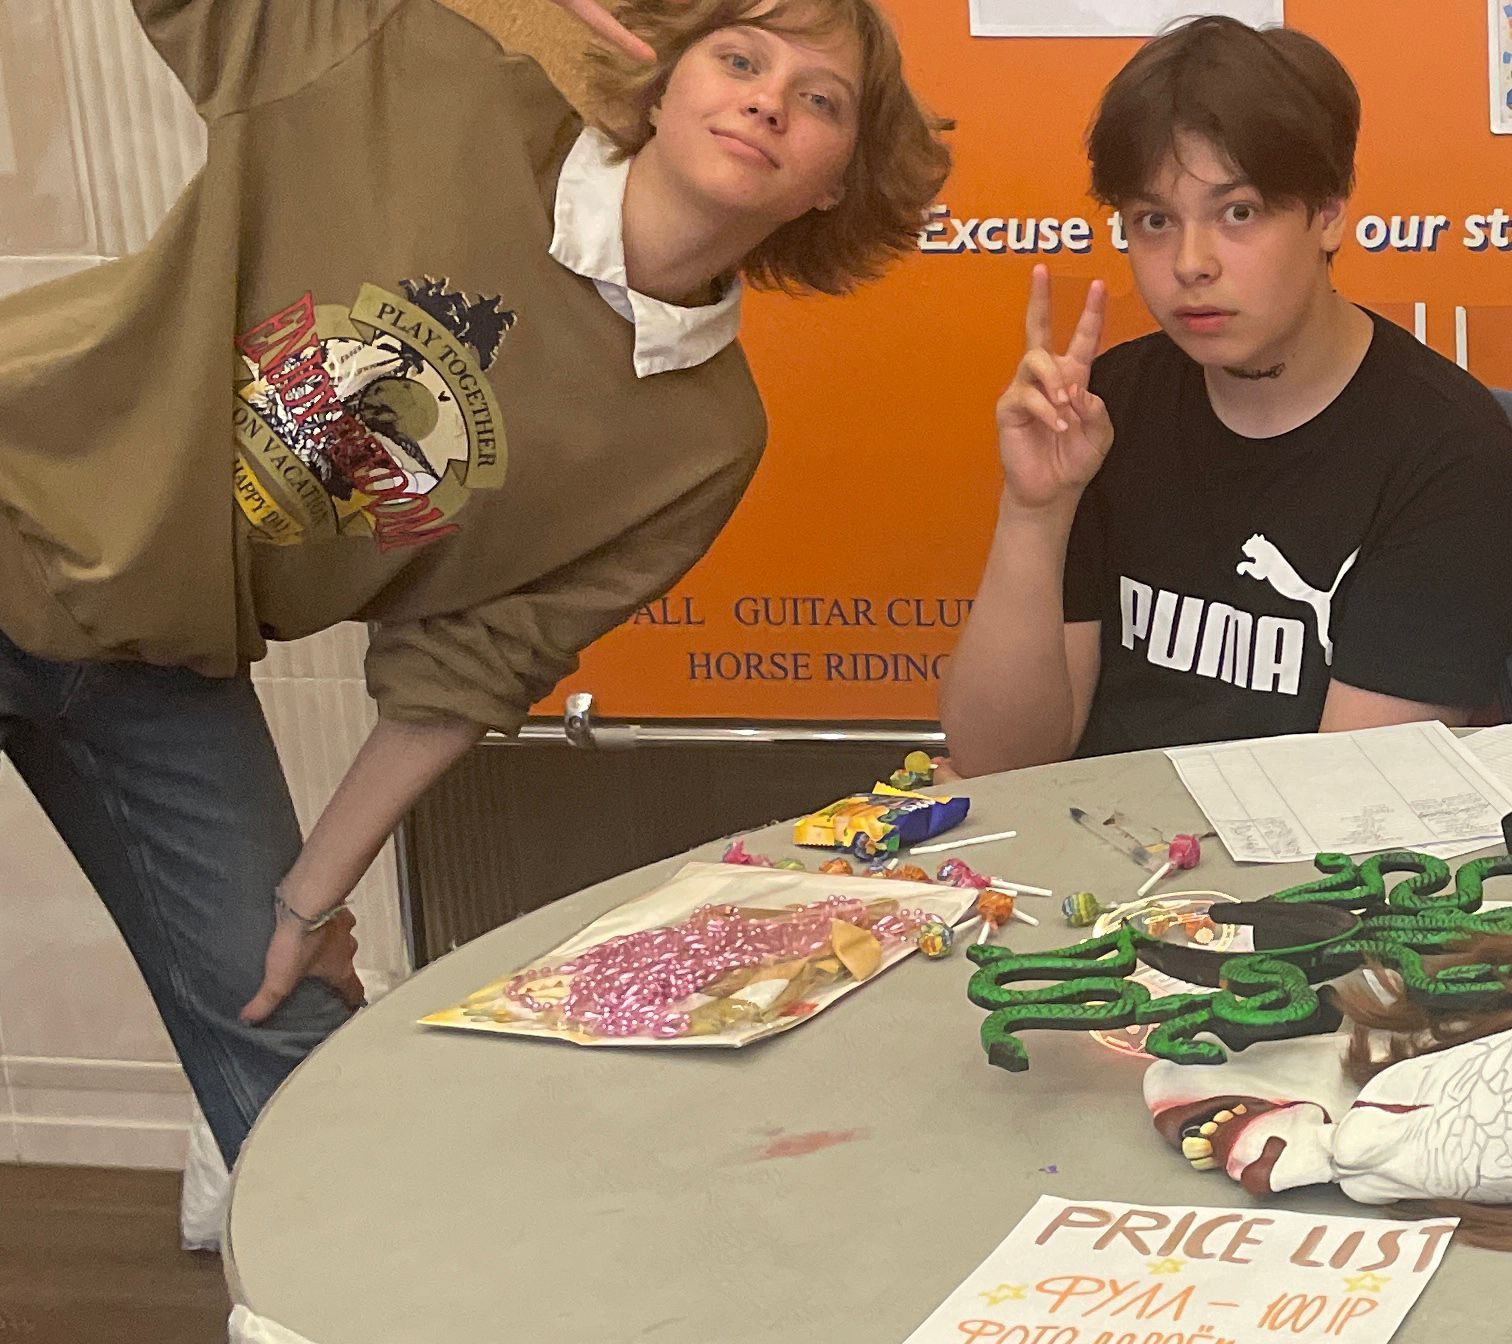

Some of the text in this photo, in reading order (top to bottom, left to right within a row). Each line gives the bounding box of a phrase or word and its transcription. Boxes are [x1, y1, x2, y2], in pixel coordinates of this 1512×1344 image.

[917, 204, 1093, 253] Excuse
[1356, 213, 1449, 253] our
[376, 302, 498, 468] PLAY TOGETHER
[632, 596, 706, 626] ALL
[734, 597, 878, 627] GUITAR
[1120, 575, 1305, 696] PUMA
[688, 651, 813, 681] HORSE
[1035, 1206, 1456, 1273] PRICE LIST
[1035, 1275, 1196, 1321] ФУЛЛ
